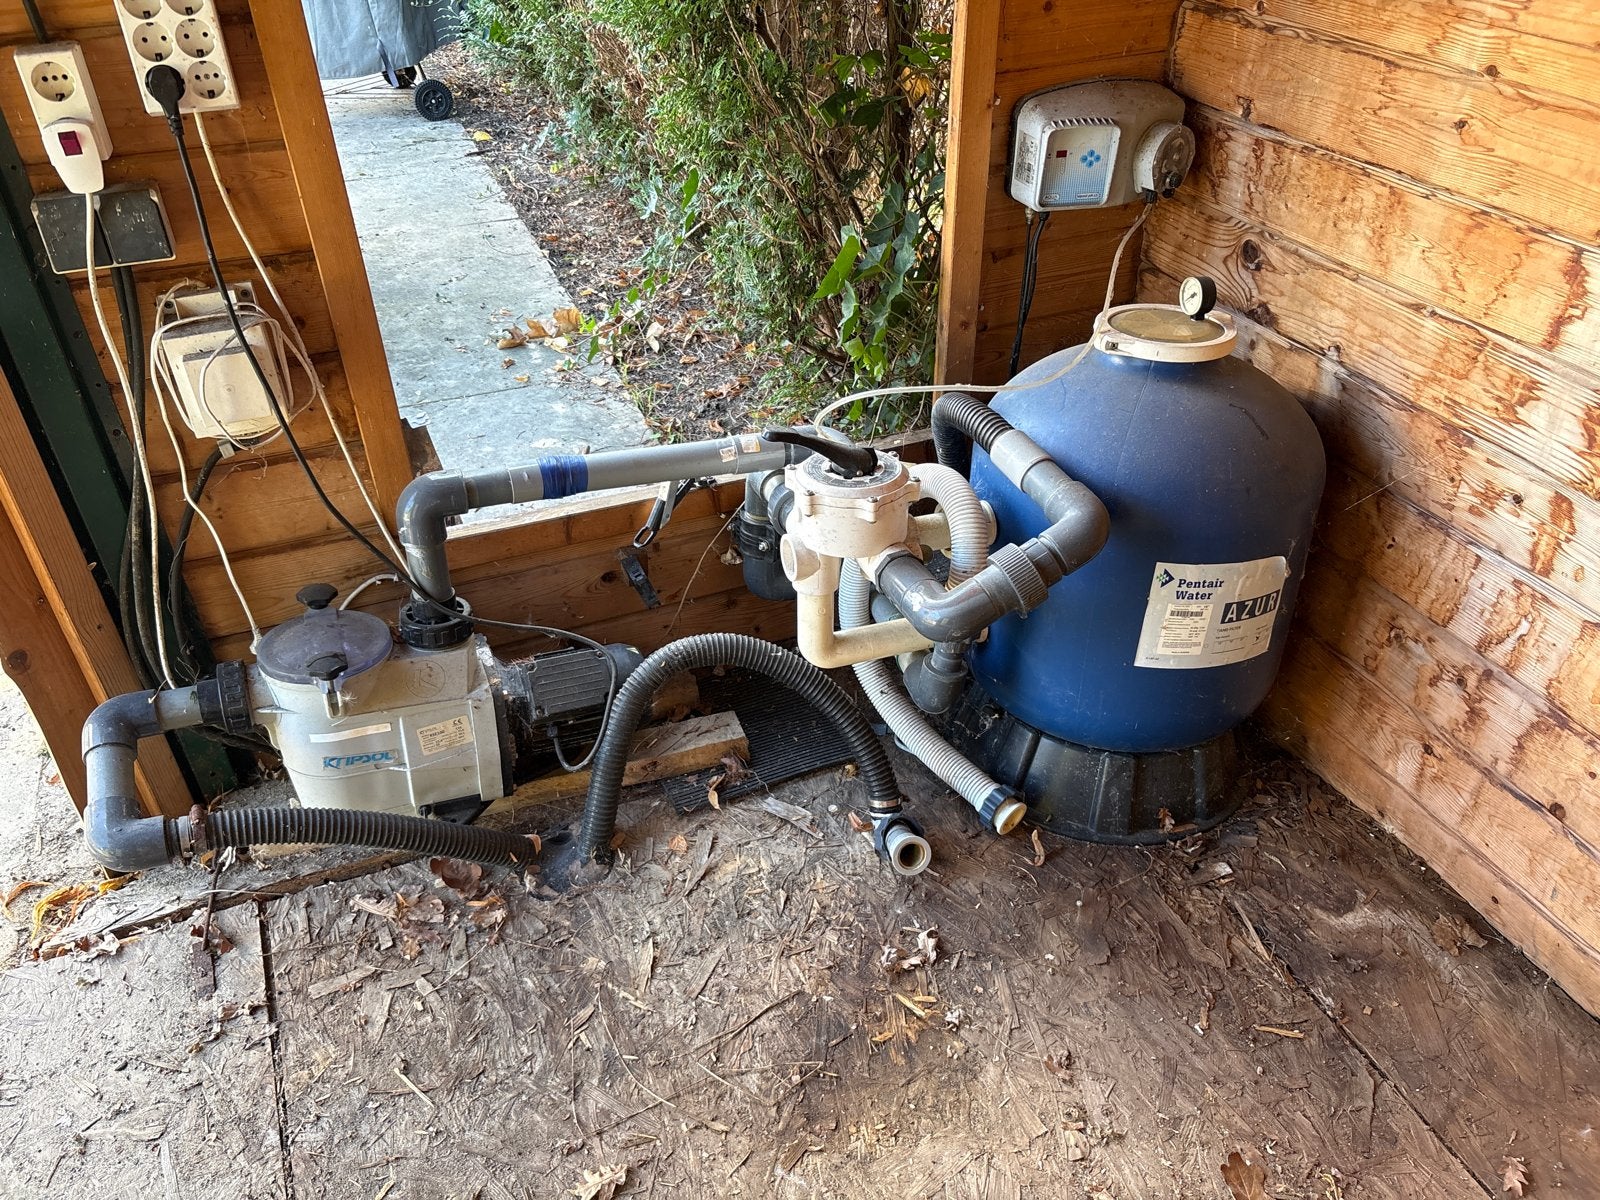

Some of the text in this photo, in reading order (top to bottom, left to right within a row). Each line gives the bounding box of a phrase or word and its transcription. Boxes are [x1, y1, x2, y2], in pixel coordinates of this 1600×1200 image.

[1177, 578, 1225, 589] Pentair
[1175, 590, 1213, 600] Water
[1225, 593, 1277, 623] AZUR
